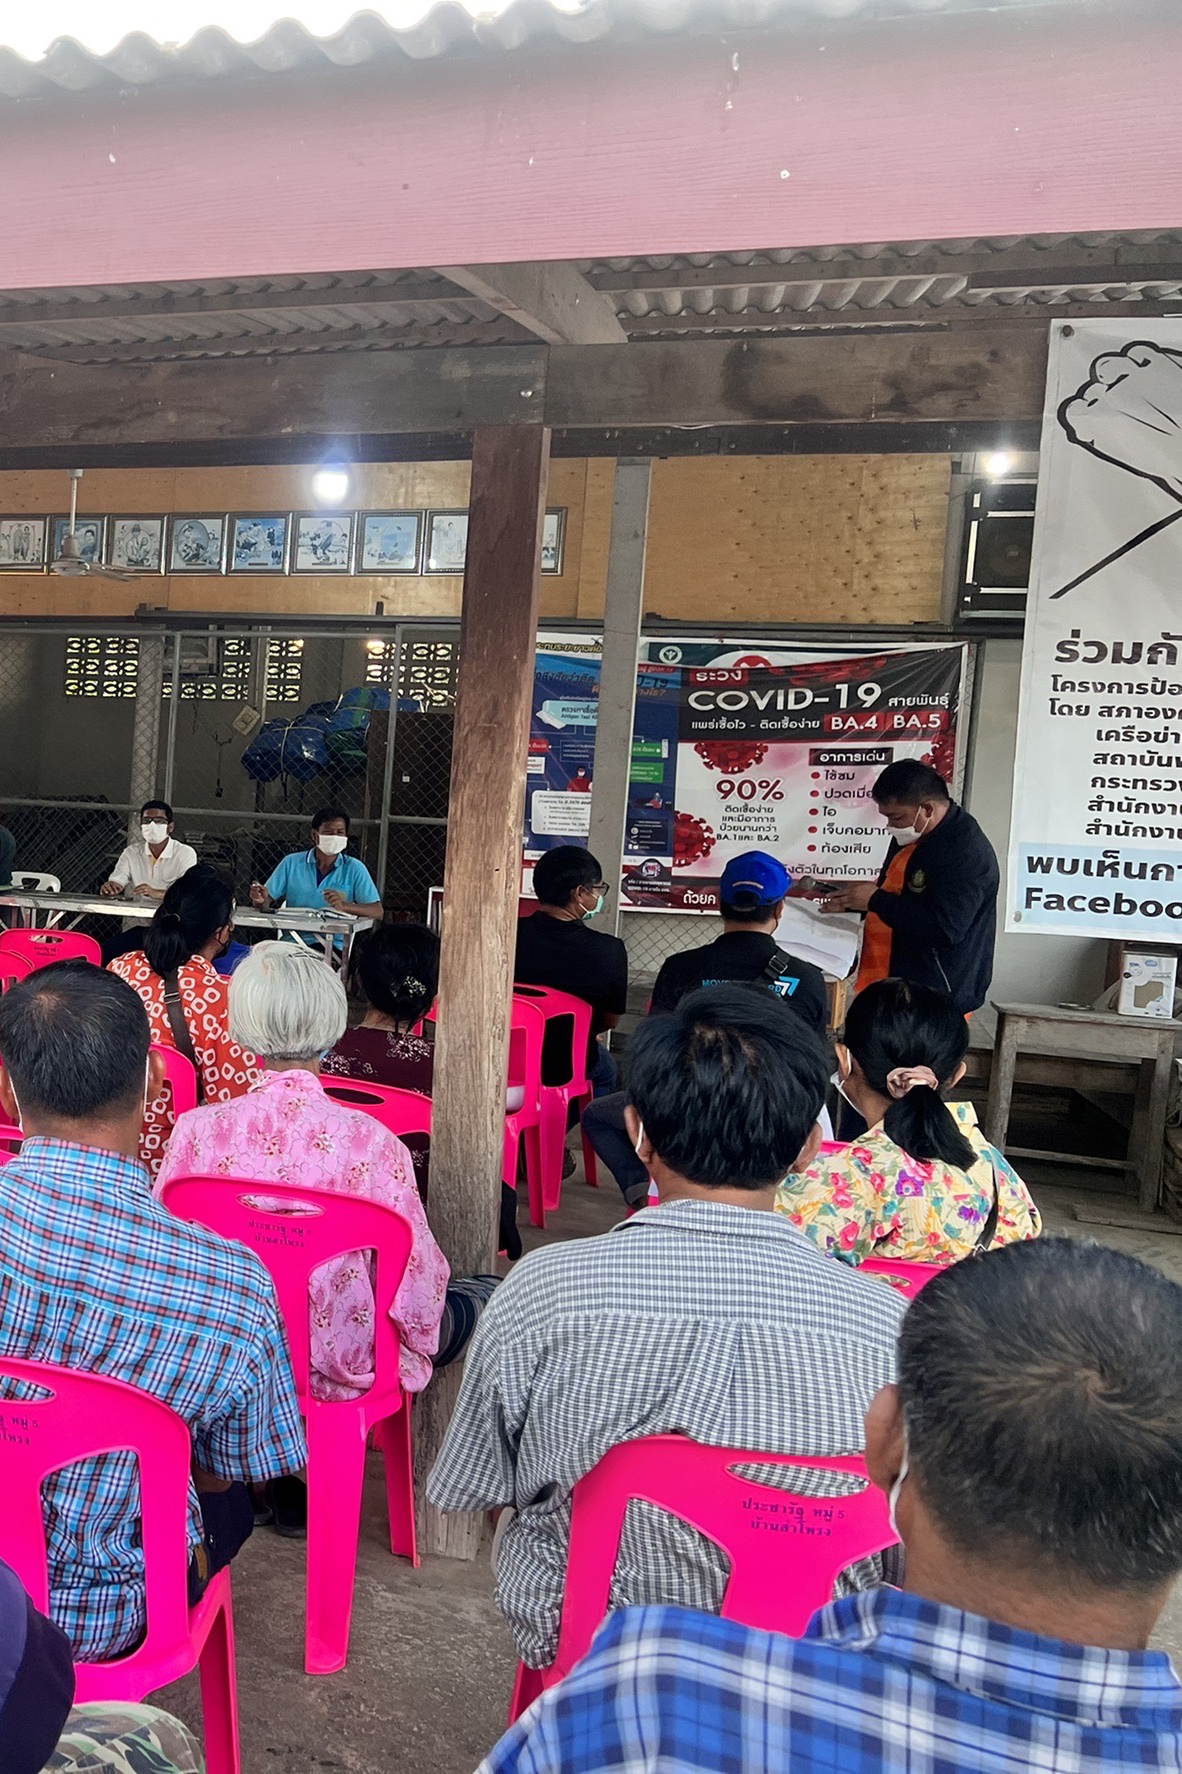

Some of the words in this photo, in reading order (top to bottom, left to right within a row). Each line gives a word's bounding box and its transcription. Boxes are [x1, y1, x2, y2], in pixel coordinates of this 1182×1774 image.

[687, 682, 882, 711] COVID-19
[888, 692, 950, 709] สายพันธุ์
[1049, 698, 1090, 717] โดย
[691, 716, 747, 729] แพร่เชื้อไว
[759, 716, 820, 729] ติดเชื้อง่าย
[830, 714, 878, 731] BA.4
[893, 713, 942, 729] BA.5
[819, 750, 886, 762] อาการเด่น
[716, 779, 785, 801] 90%
[1090, 776, 1182, 793] กระทรว
[724, 803, 774, 813] ติดเชื้อง่าย
[822, 806, 837, 817] ไอ
[1087, 795, 1182, 816] สำนักงา
[721, 814, 776, 823] และมีอาการ
[719, 823, 777, 832] ป่วยนานกว่า
[757, 834, 780, 842] BA.2
[819, 842, 872, 854] ท้องเสีย
[1026, 850, 1182, 882] พบเห็นก
[741, 1497, 805, 1519] ประชารัฐ
[837, 1510, 845, 1519] 5
